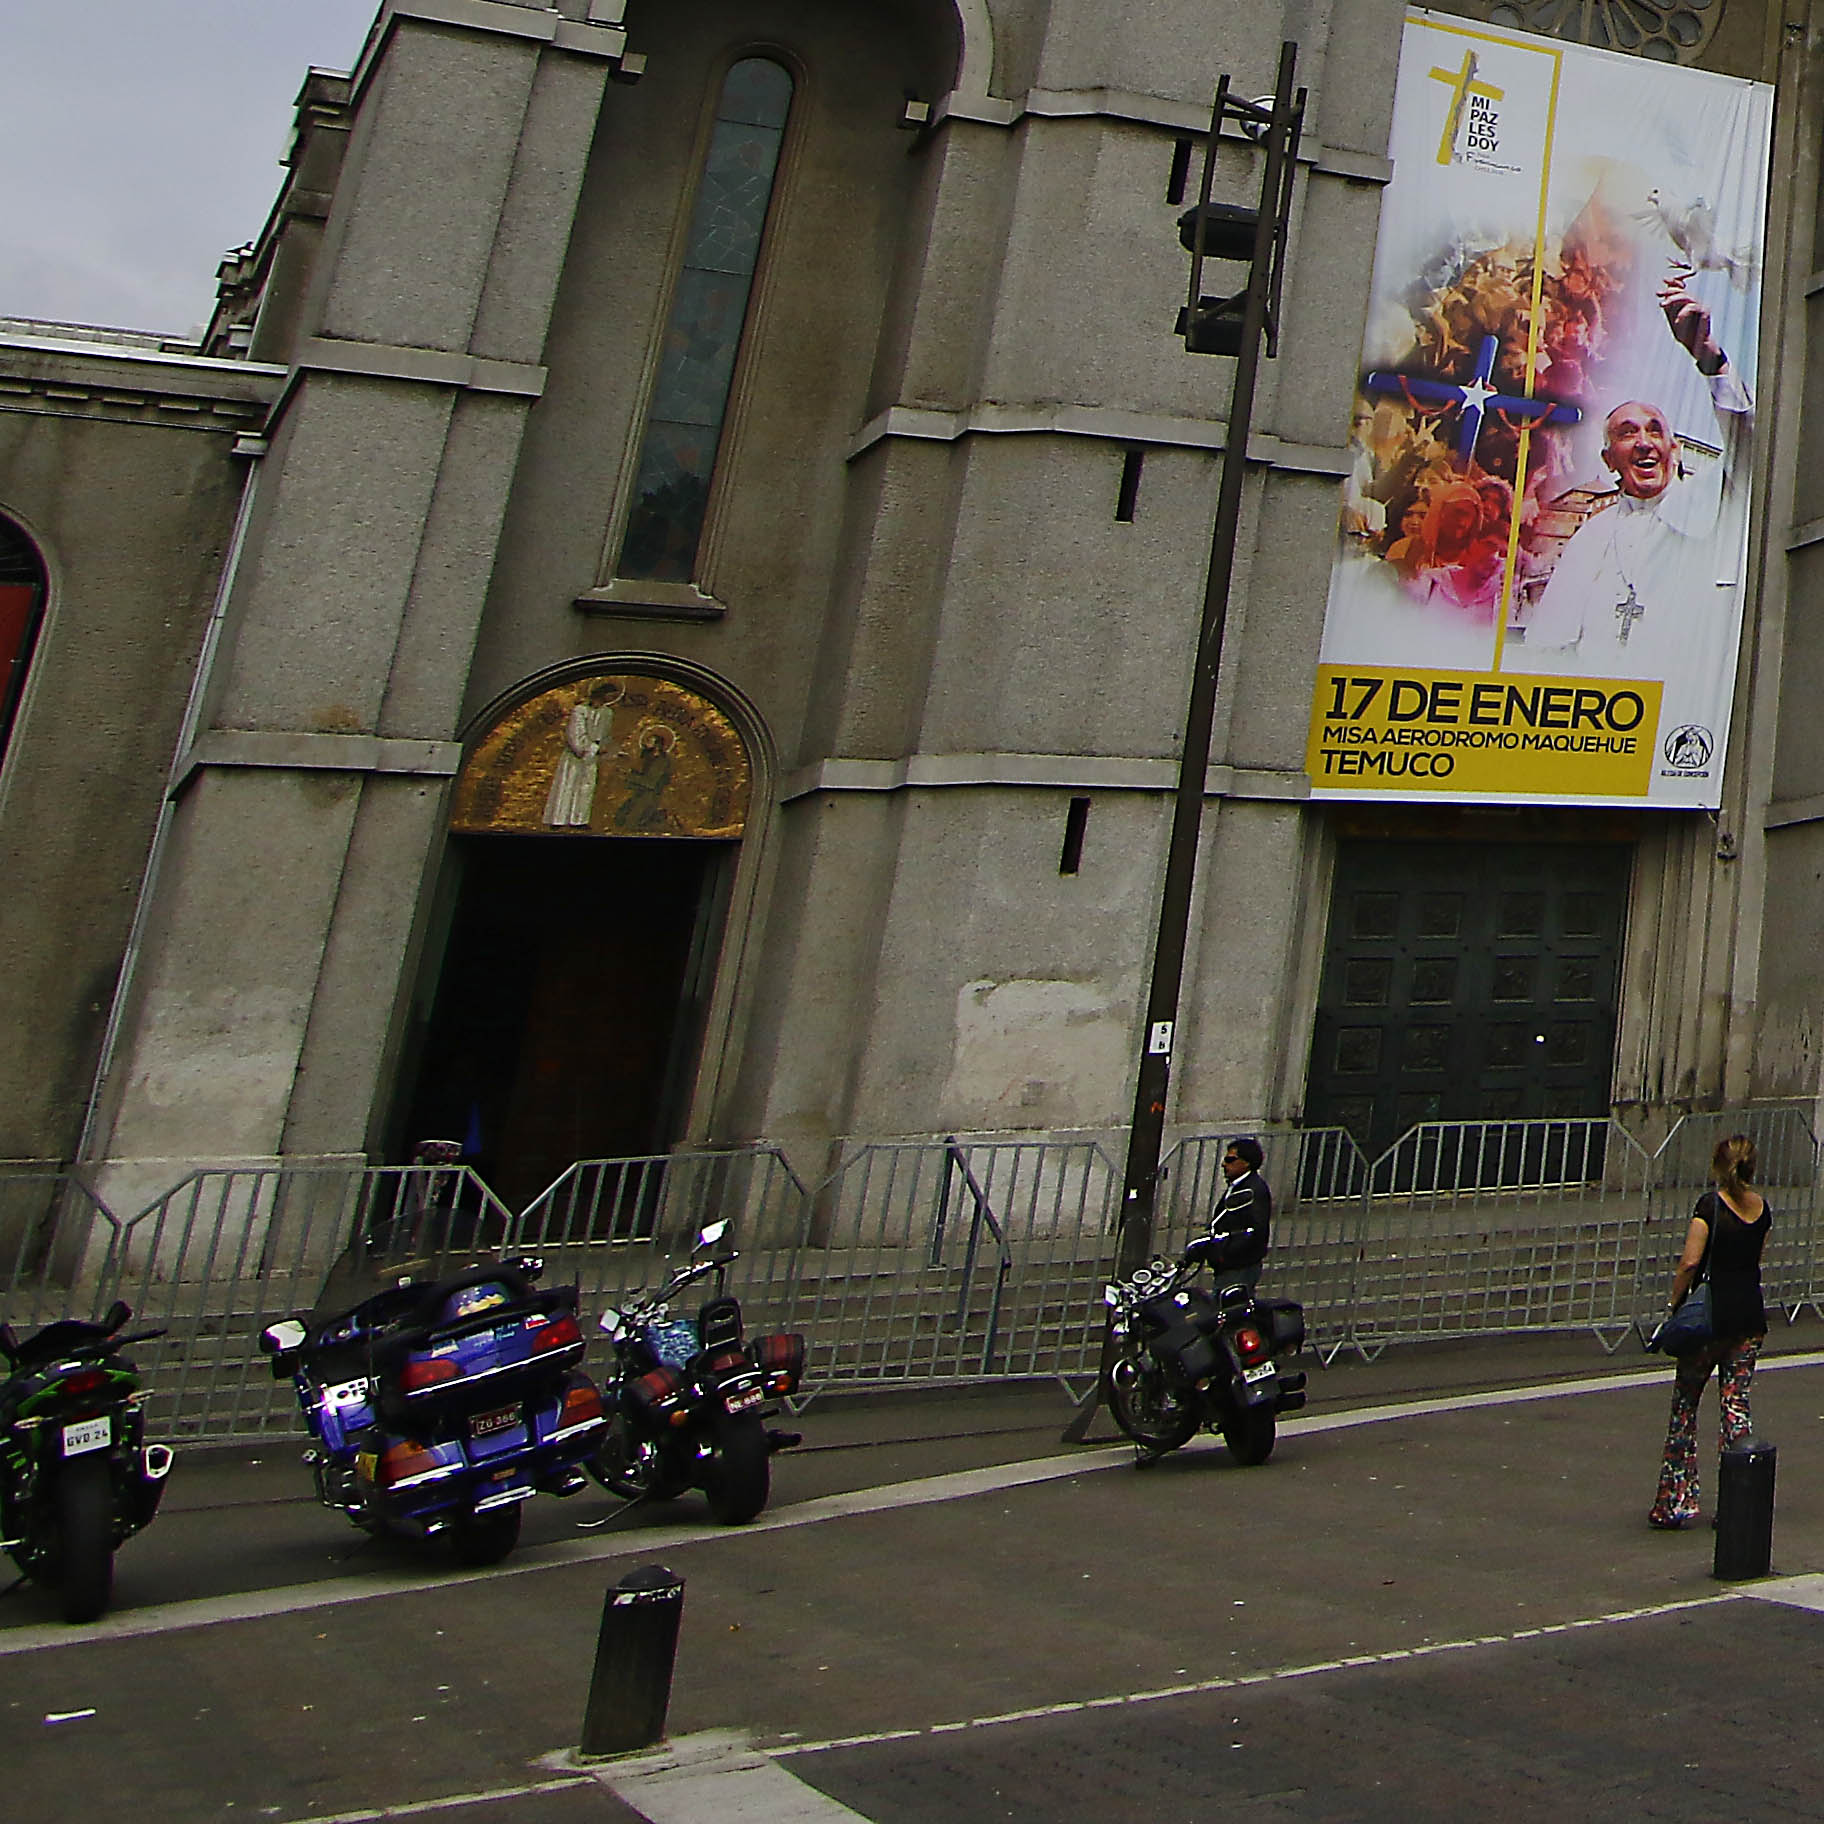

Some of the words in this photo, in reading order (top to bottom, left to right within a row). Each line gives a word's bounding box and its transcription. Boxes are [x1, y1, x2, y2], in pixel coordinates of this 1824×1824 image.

[1471, 96, 1490, 110] MI
[1470, 109, 1498, 125] PAZ
[1469, 122, 1495, 138] LES
[1467, 135, 1499, 152] DOY
[1325, 677, 1384, 721] 17
[1387, 679, 1463, 725] DE
[1468, 683, 1645, 732] ENERO
[1322, 726, 1379, 745] MISA
[1379, 727, 1520, 750] AERODROMO
[1521, 734, 1638, 755] MAQUEHUE
[1319, 748, 1455, 778] TEMUCO
